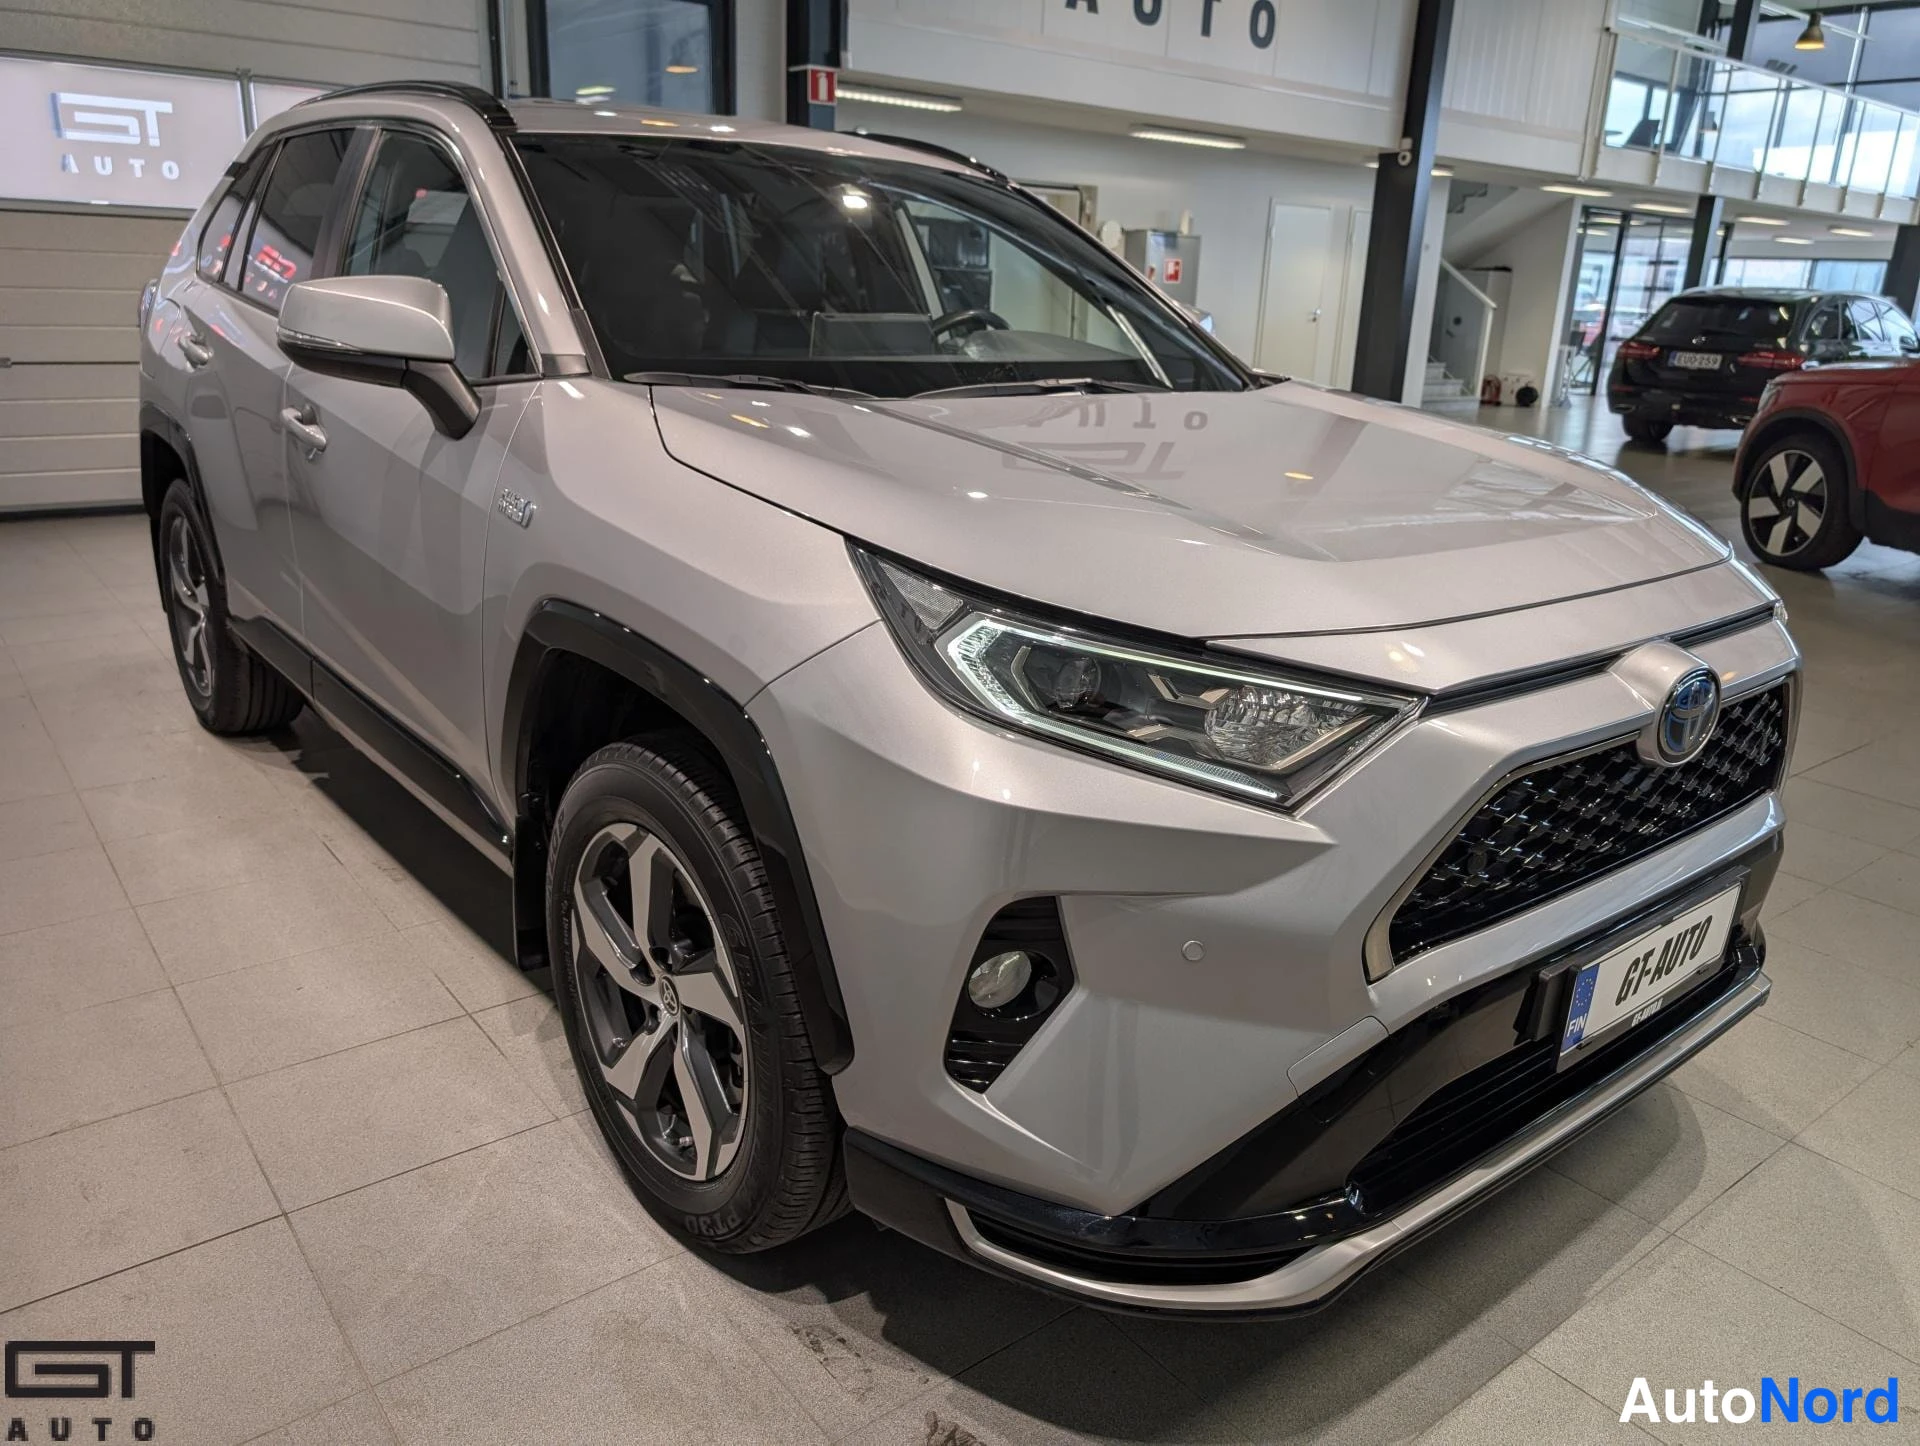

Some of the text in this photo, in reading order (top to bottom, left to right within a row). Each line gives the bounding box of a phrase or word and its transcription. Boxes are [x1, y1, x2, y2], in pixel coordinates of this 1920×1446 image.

[1065, 0, 1276, 49] UTO
[61, 153, 180, 180] AUTO
[1615, 915, 1713, 1006] GT-AUTO
[1566, 1013, 1588, 1038] FIN
